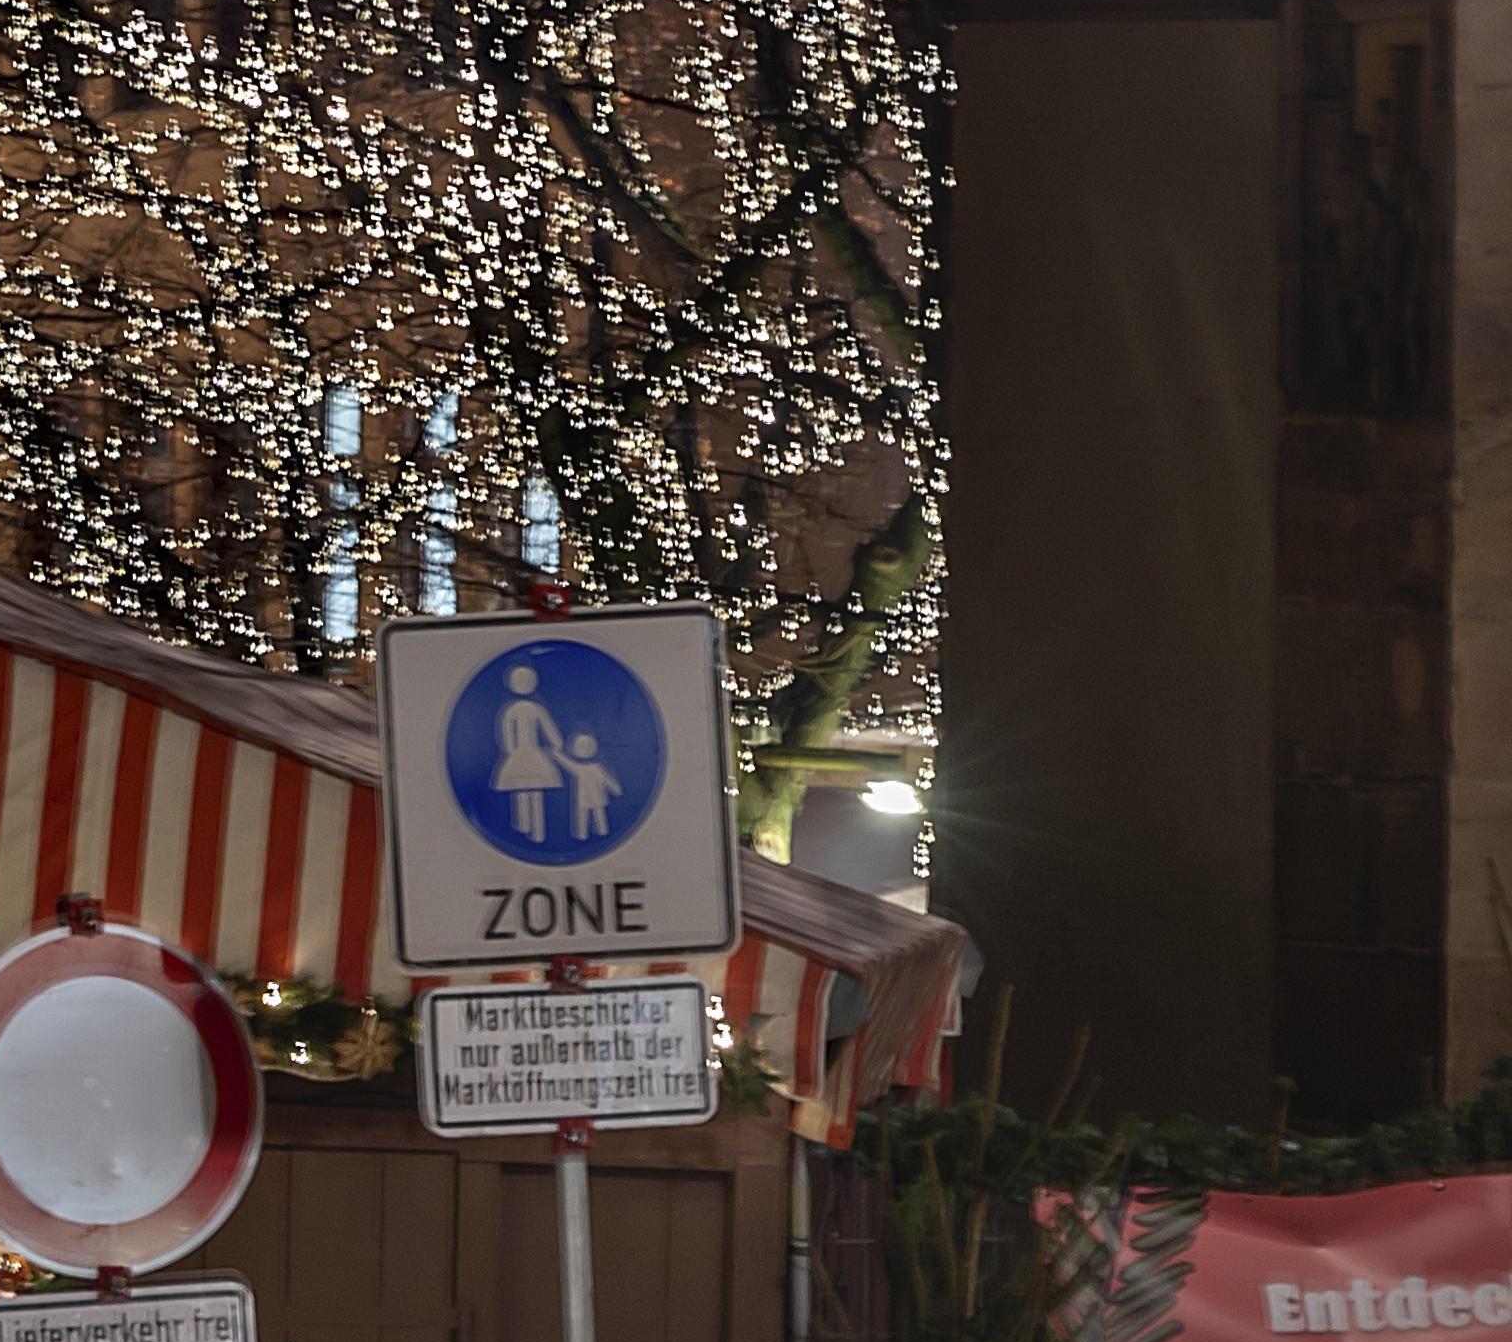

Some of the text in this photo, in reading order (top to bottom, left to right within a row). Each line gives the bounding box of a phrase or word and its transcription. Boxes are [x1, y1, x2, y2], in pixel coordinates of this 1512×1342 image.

[482, 881, 649, 941] ZONE
[465, 993, 673, 1033] Marktbeschicker
[460, 1028, 684, 1068] nur außerhalb der
[443, 1064, 706, 1109] Marktöffnungszeit frei
[1267, 1275, 1512, 1333] Entdec
